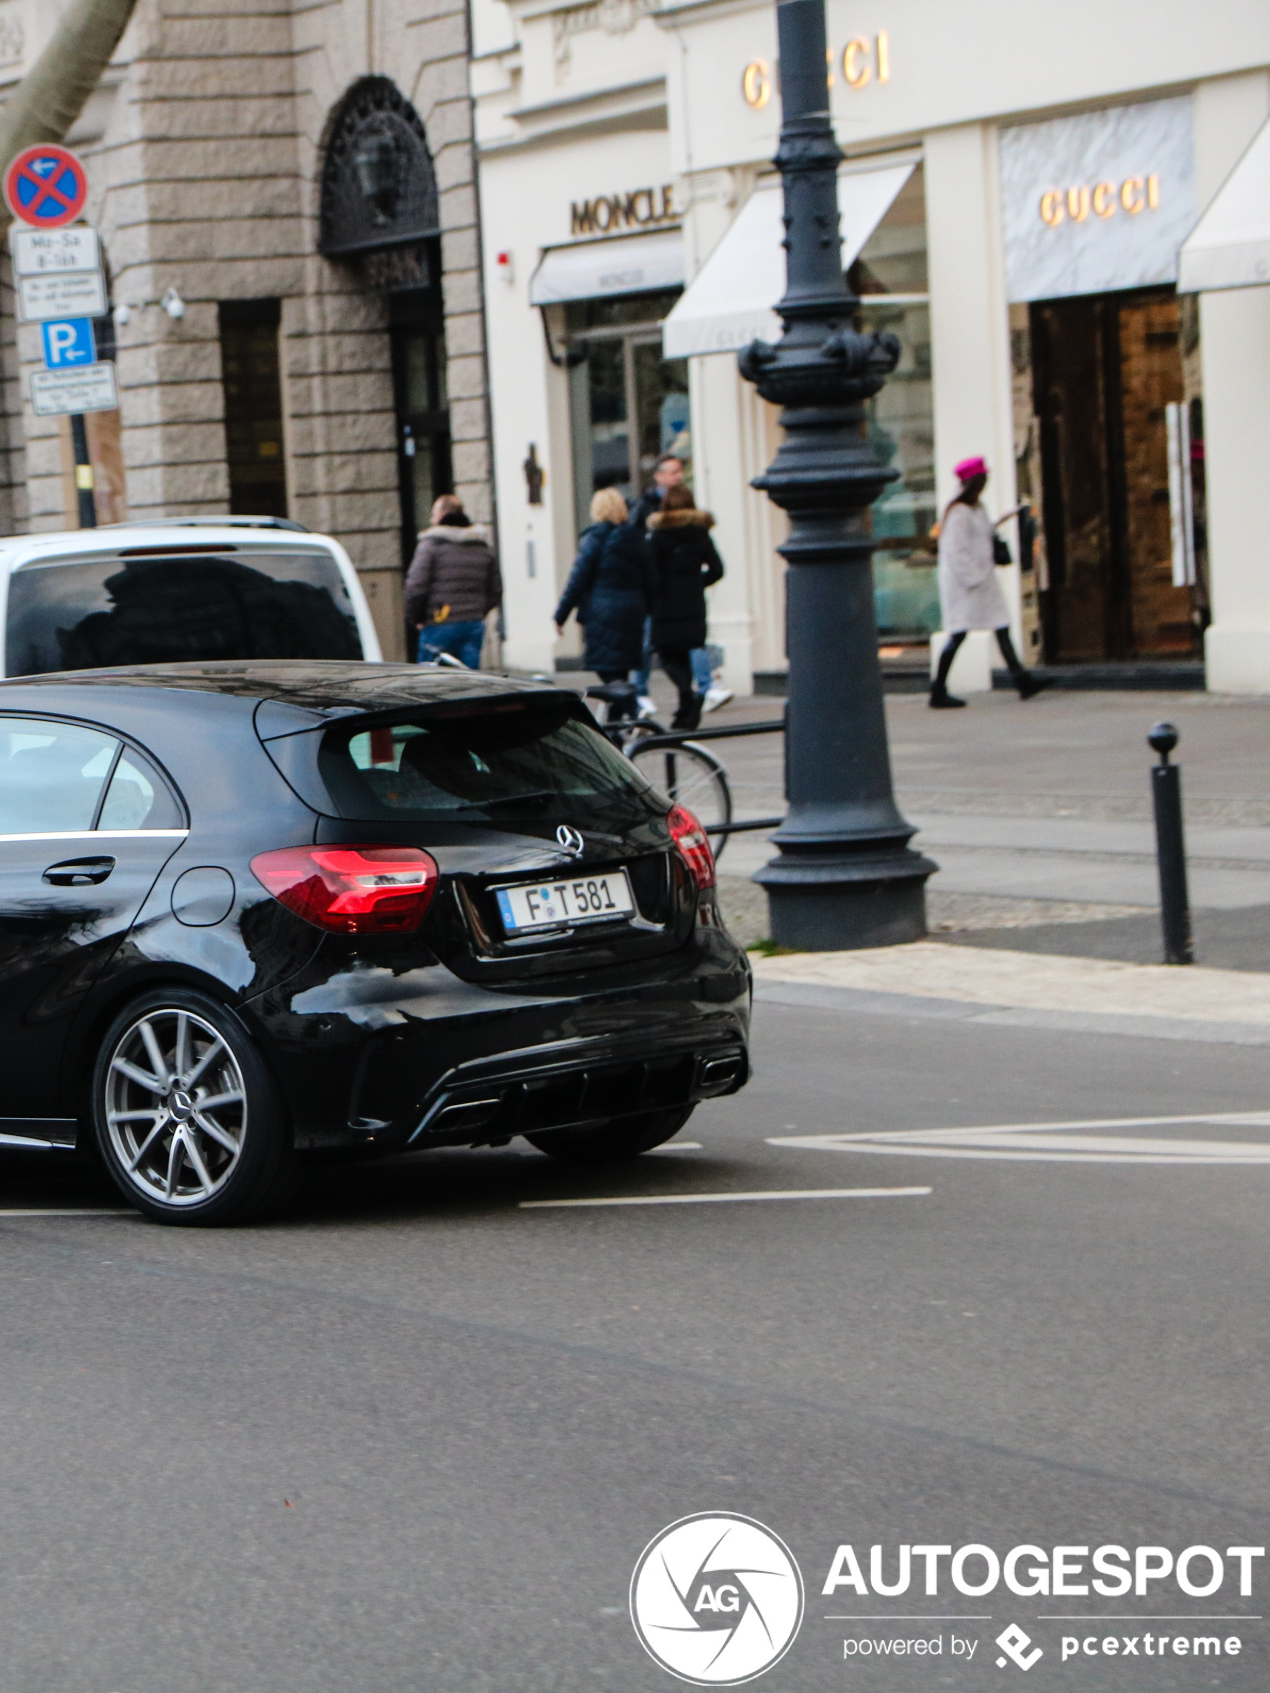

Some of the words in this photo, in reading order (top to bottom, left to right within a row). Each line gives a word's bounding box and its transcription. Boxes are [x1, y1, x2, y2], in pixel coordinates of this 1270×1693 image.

[743, 29, 889, 109] GCI
[571, 185, 683, 235] MONCLE
[1040, 173, 1159, 226] GUCCI
[48, 323, 77, 363] P
[525, 889, 540, 920] F
[554, 885, 569, 915] T
[572, 879, 616, 912] 581
